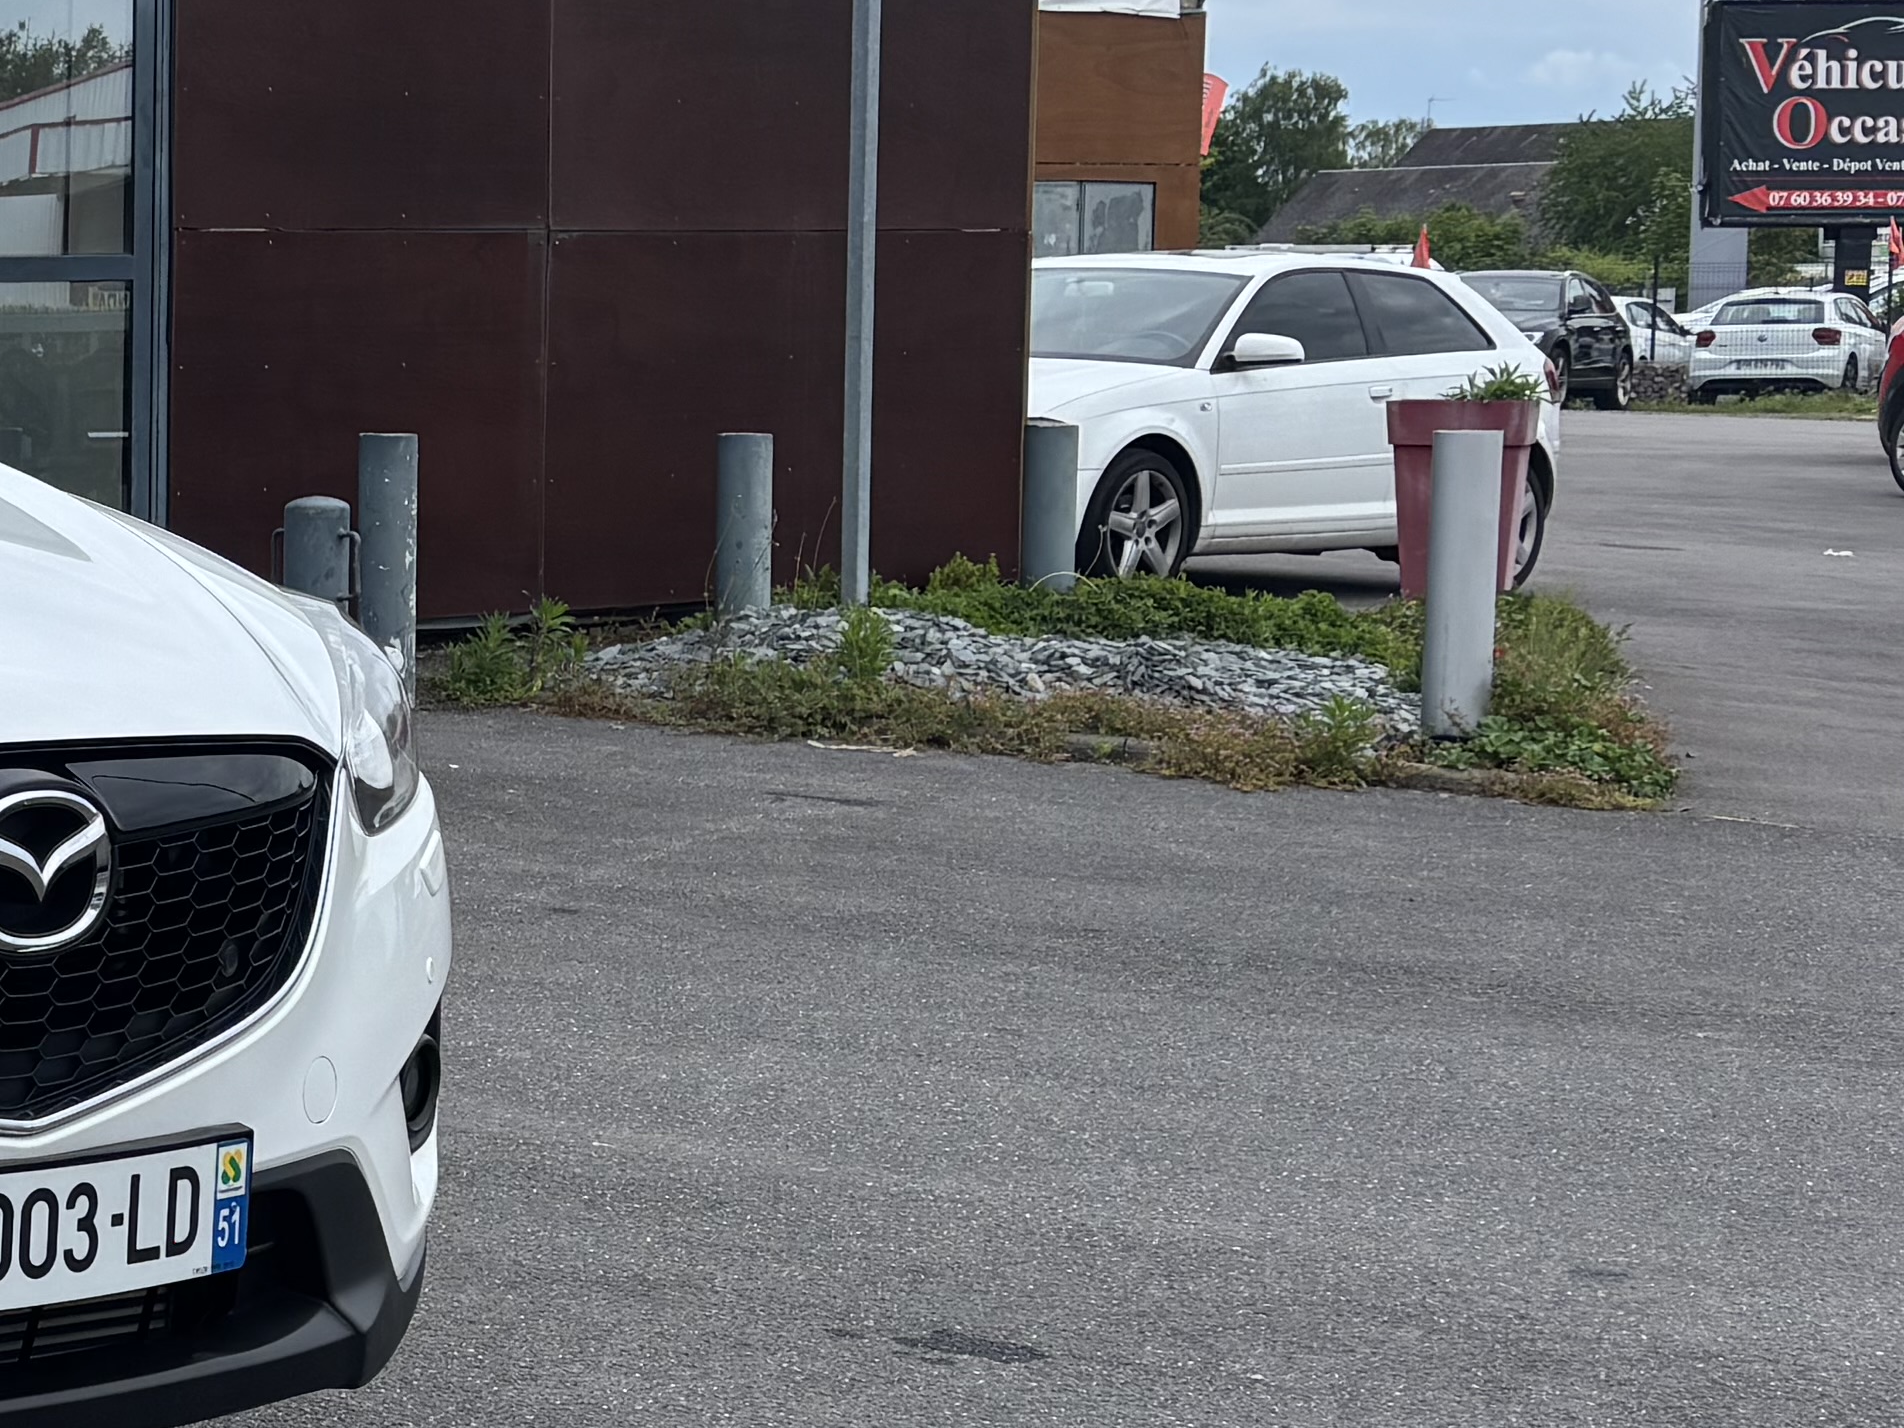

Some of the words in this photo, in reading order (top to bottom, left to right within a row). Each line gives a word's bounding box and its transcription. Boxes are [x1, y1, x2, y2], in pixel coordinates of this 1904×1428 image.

[1773, 96, 1904, 150] Occa
[1730, 158, 1770, 171] Achat
[1783, 158, 1820, 171] Vente
[1833, 158, 1872, 174] Dépot
[1769, 192, 1787, 206] 07
[1791, 192, 1810, 206] 60
[1812, 192, 1832, 206] 36
[1834, 192, 1853, 206] 39
[1855, 192, 1874, 206] 34
[217, 1205, 241, 1248] 51
